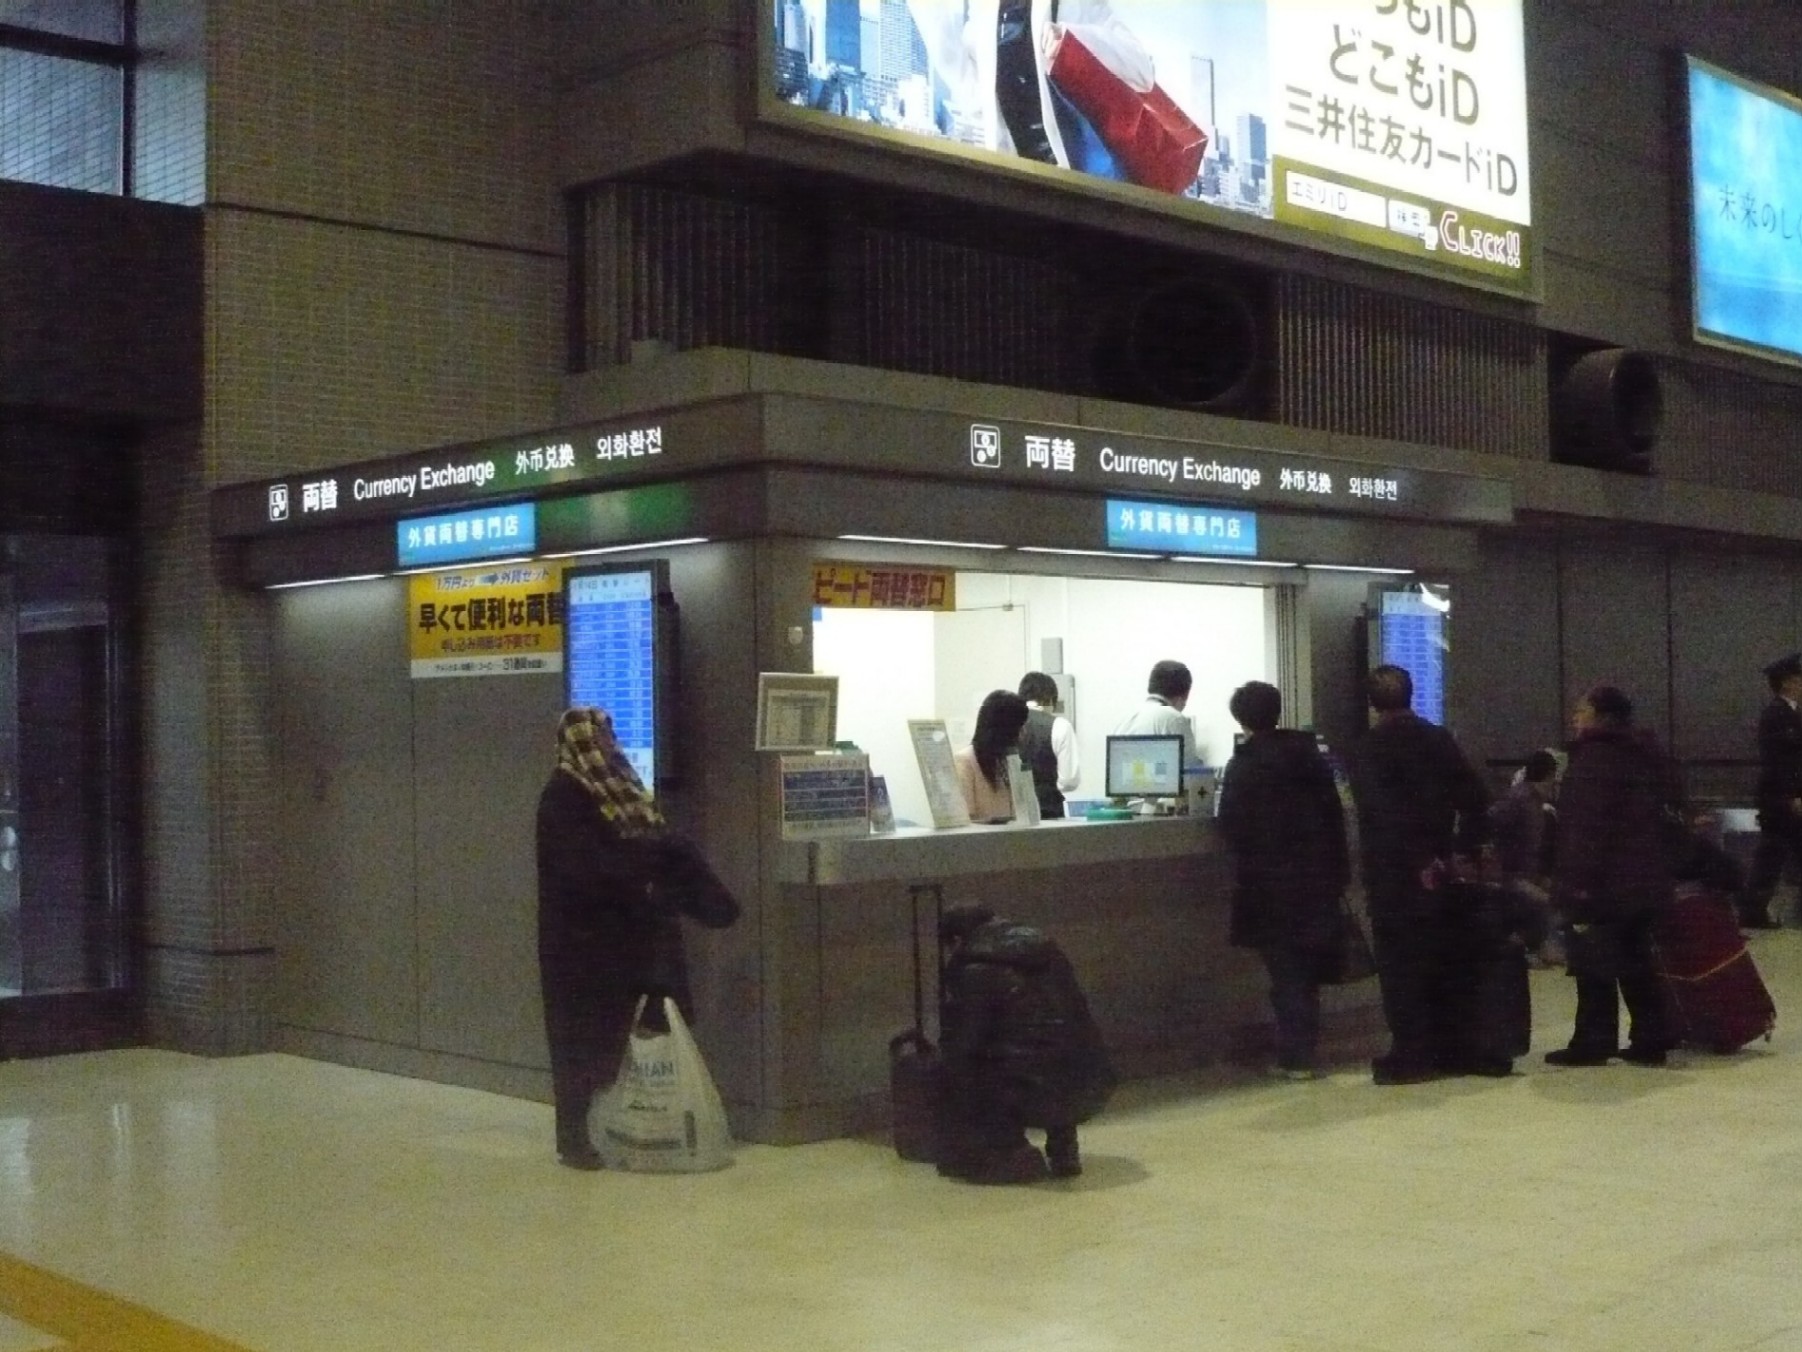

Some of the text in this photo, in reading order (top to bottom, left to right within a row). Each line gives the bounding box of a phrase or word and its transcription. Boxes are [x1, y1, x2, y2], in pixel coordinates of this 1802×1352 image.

[1329, 24, 1479, 126] どこもiD
[1285, 84, 1518, 197] 三井住友カードiD
[1719, 183, 1802, 243] 未来のし
[596, 426, 663, 462] 외화환전
[1024, 434, 1077, 473] 両替
[354, 459, 495, 501] Currency Exchange
[1099, 447, 1261, 491] Currency Exchange
[1348, 476, 1398, 502] 외화환전
[302, 479, 338, 513] 両替
